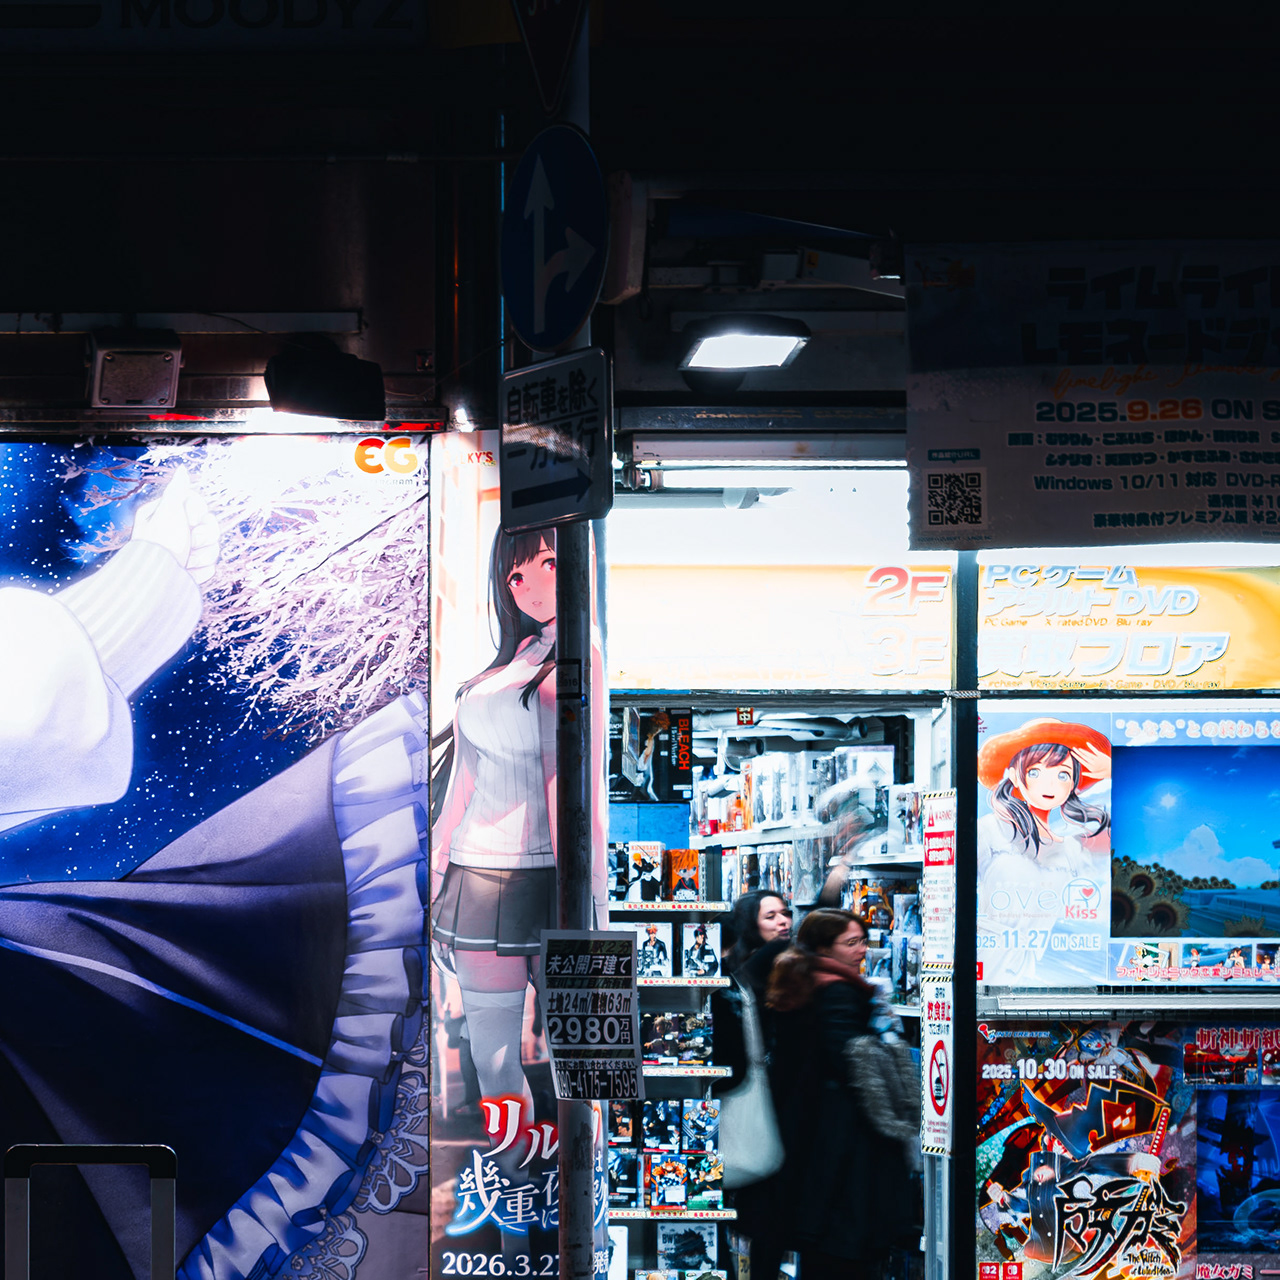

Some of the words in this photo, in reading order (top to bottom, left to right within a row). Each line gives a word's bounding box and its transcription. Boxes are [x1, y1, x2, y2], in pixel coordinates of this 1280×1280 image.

[1046, 265, 1280, 310] ライムライ
[1020, 317, 1280, 364] レモネードジ
[507, 367, 599, 423] 自転車を除く
[1036, 399, 1202, 422] 2025.9.26
[1212, 399, 1253, 420] ON
[507, 415, 598, 471] 一方通行
[1034, 475, 1113, 490] Windows
[1120, 472, 1179, 489] 10/11
[863, 565, 950, 615] 2F
[678, 718, 690, 770] BLEACH
[990, 889, 1058, 911] ove
[1065, 905, 1098, 919] Kiss
[977, 930, 1049, 949] 025.11.27
[1052, 935, 1066, 949] ON
[1071, 935, 1099, 949] SALE
[546, 954, 632, 975] 未公開戸建て
[548, 1016, 631, 1044] 2980万円
[982, 1058, 1066, 1080] 2025.10.30
[1087, 1064, 1118, 1080] SALE
